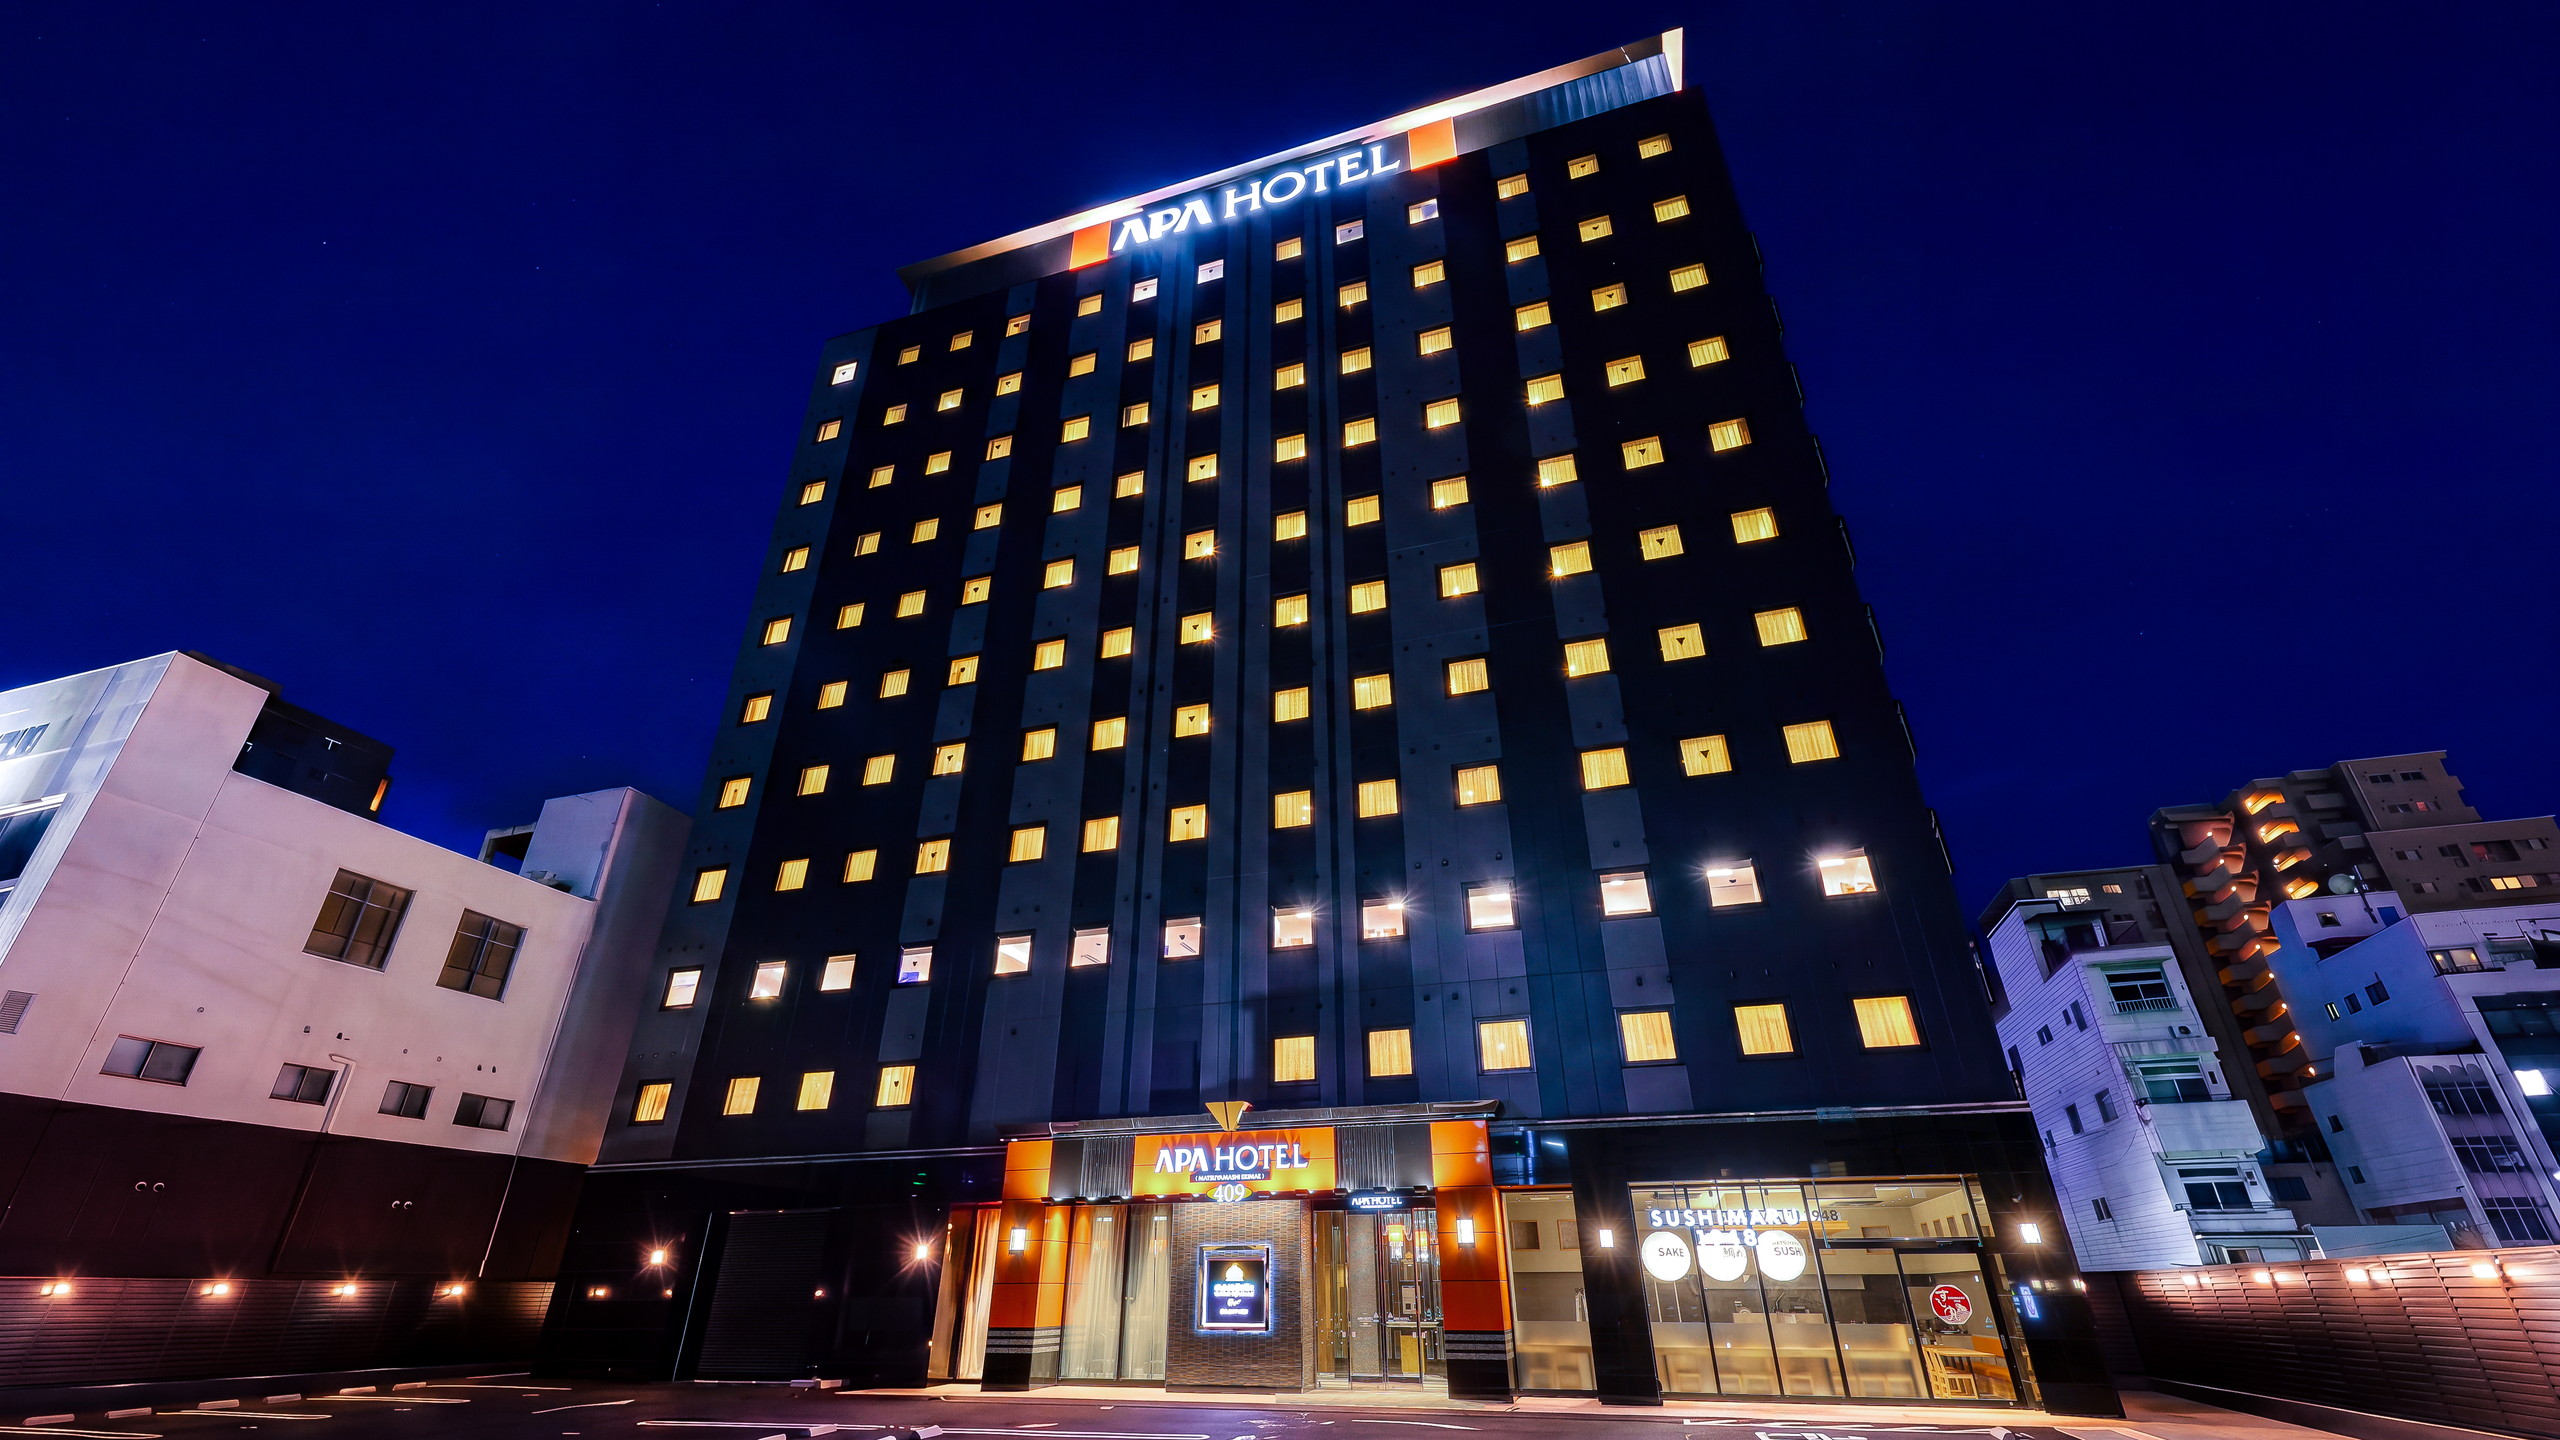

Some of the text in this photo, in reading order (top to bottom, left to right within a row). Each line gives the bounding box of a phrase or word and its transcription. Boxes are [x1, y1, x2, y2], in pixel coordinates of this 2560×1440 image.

[1112, 144, 1401, 251] APA HOTEL
[1154, 1143, 1309, 1173] APA HOTEL
[1213, 1183, 1245, 1203] 409
[1351, 1196, 1403, 1206] APA HOTEL
[1650, 1208, 1800, 1227] SUSHIMARU
[1804, 1209, 1839, 1221] 948
[1658, 1247, 1685, 1258] SAKE
